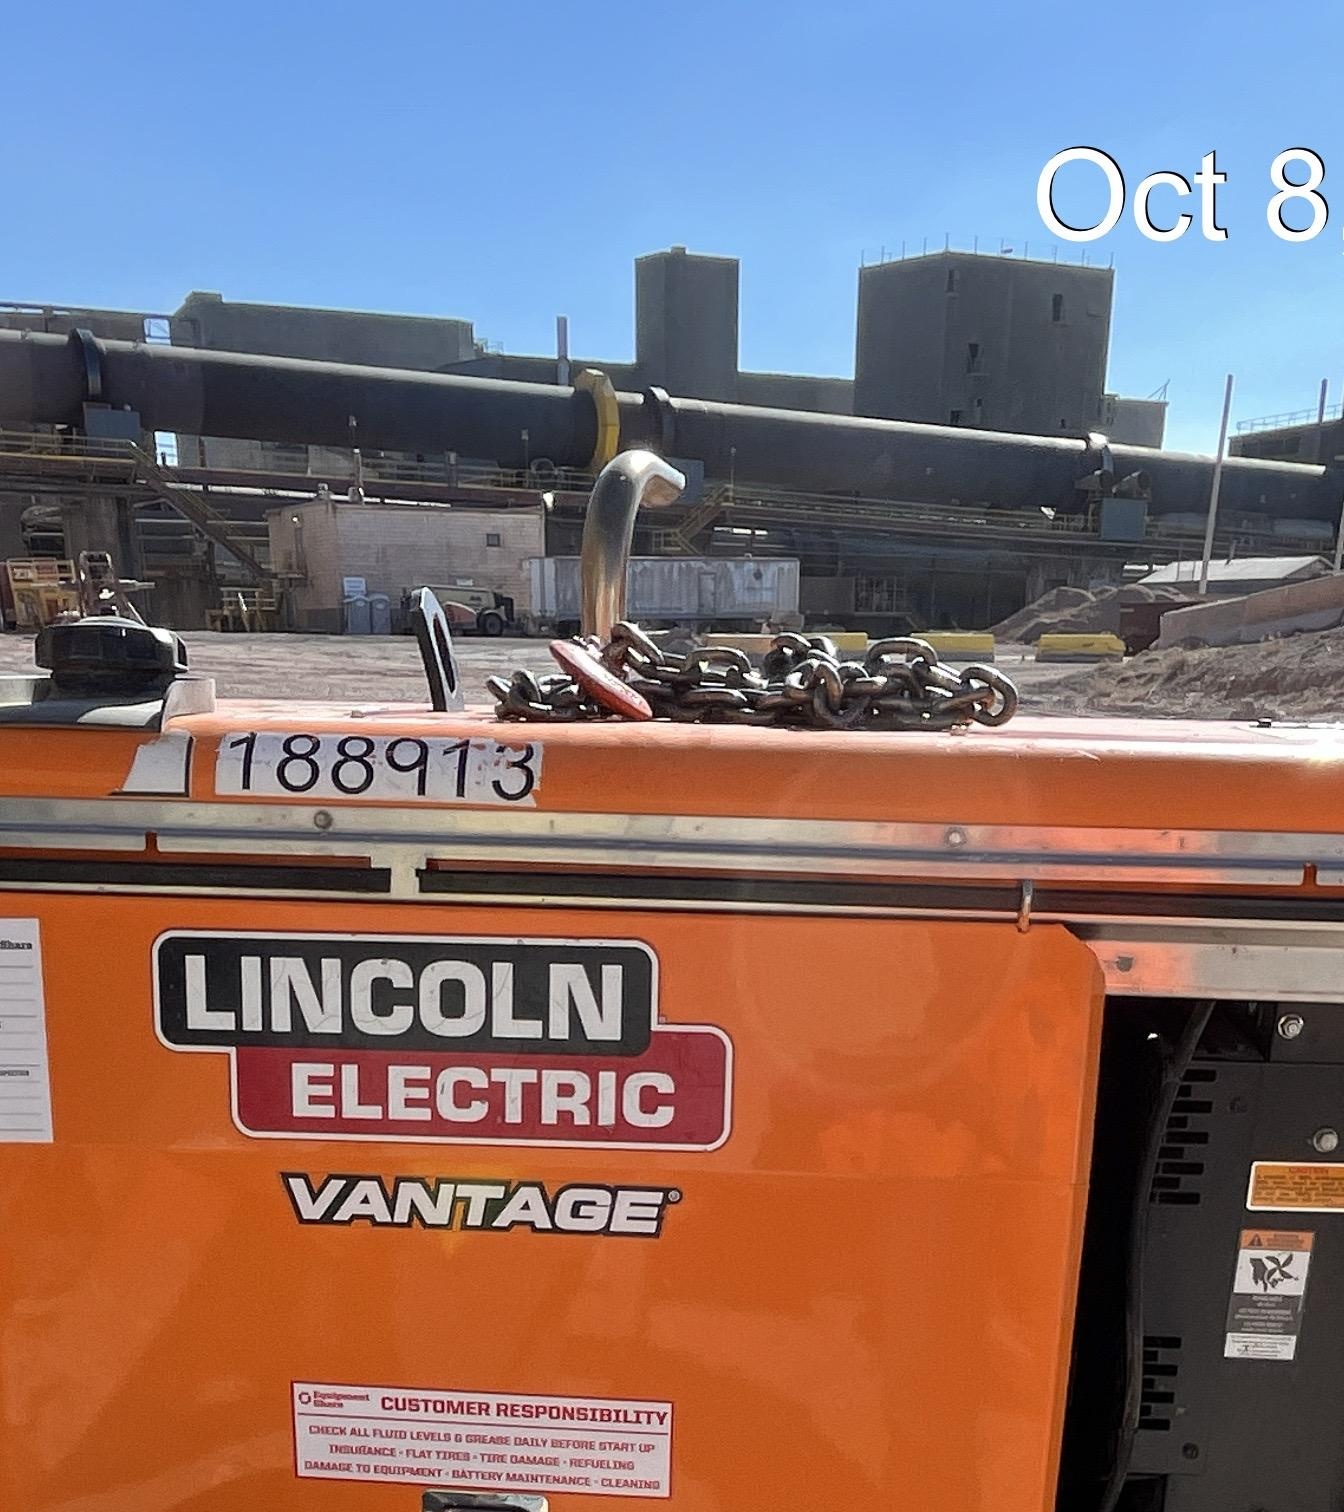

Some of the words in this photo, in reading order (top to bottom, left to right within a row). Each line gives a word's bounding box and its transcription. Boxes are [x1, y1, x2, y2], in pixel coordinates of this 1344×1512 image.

[229, 731, 537, 802] 188913
[184, 954, 624, 1042] LINCOLN
[291, 1062, 676, 1128] ELECTRIC
[287, 1177, 664, 1233] VANTAGE
[381, 1396, 491, 1416] CUSTOMER
[496, 1401, 668, 1426] RESPONSIBILITY
[308, 1424, 348, 1438] CHECK
[350, 1426, 370, 1438] ALL
[372, 1428, 406, 1440] FLUID
[410, 1431, 452, 1443] LEVELS
[465, 1433, 511, 1446] GREASE
[513, 1435, 548, 1448] DAILY
[550, 1438, 596, 1451] BEFORE
[598, 1441, 636, 1452] START
[638, 1443, 656, 1453] UP
[329, 1443, 397, 1458] INSURANCE
[405, 1447, 433, 1460] FLAT
[434, 1449, 470, 1462] TIRES
[479, 1452, 507, 1464] TIRE
[509, 1454, 560, 1467] DAMAGE
[569, 1457, 635, 1471] REFUELING
[304, 1460, 354, 1473] DAMAGE
[356, 1463, 371, 1474] TO
[373, 1464, 443, 1478] EQUIPMENT
[452, 1469, 503, 1482] BATTERY
[506, 1471, 591, 1487] MAINTENANCE
[600, 1477, 661, 1490] CLEANING
